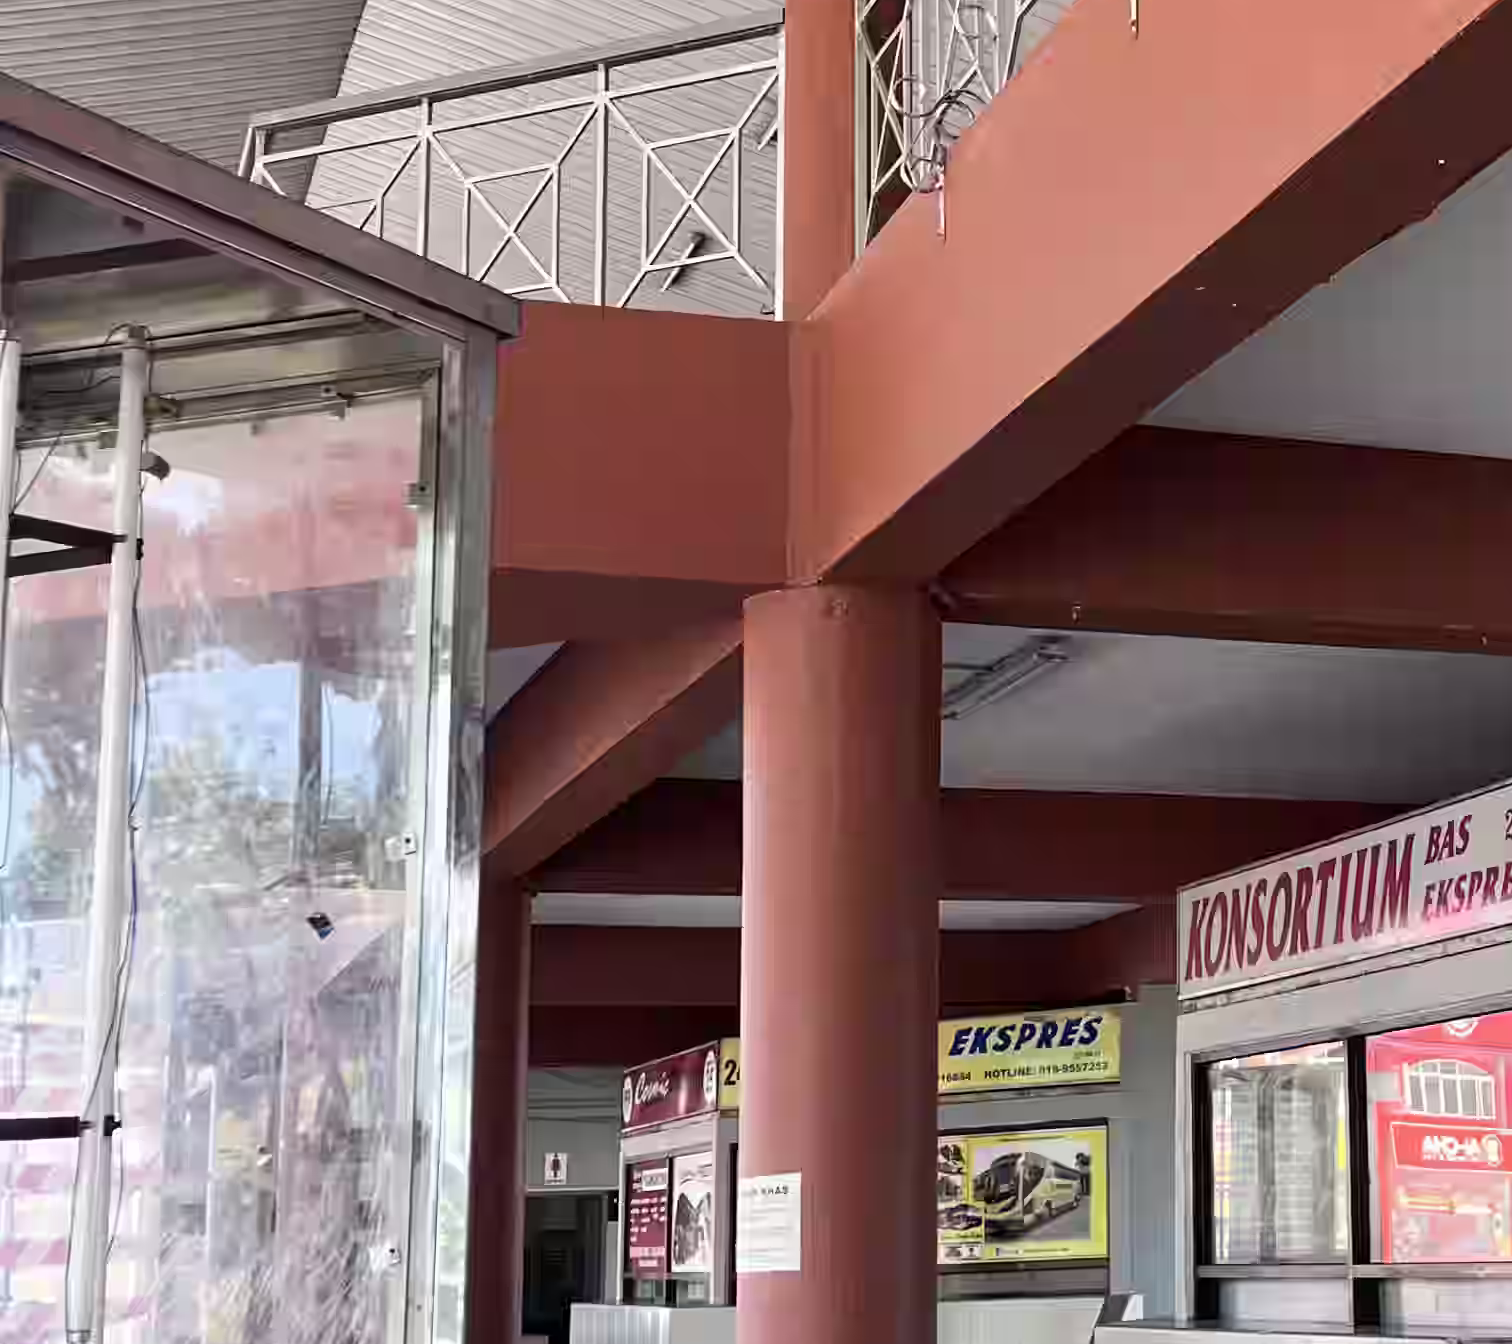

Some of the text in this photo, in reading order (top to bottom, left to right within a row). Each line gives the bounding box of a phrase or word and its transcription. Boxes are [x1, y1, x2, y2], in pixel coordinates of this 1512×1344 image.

[1424, 814, 1472, 865] BAS
[1184, 832, 1415, 981] KONSORTIUM
[948, 1015, 1104, 1056] EKSPRES
[723, 1059, 740, 1086] 2
